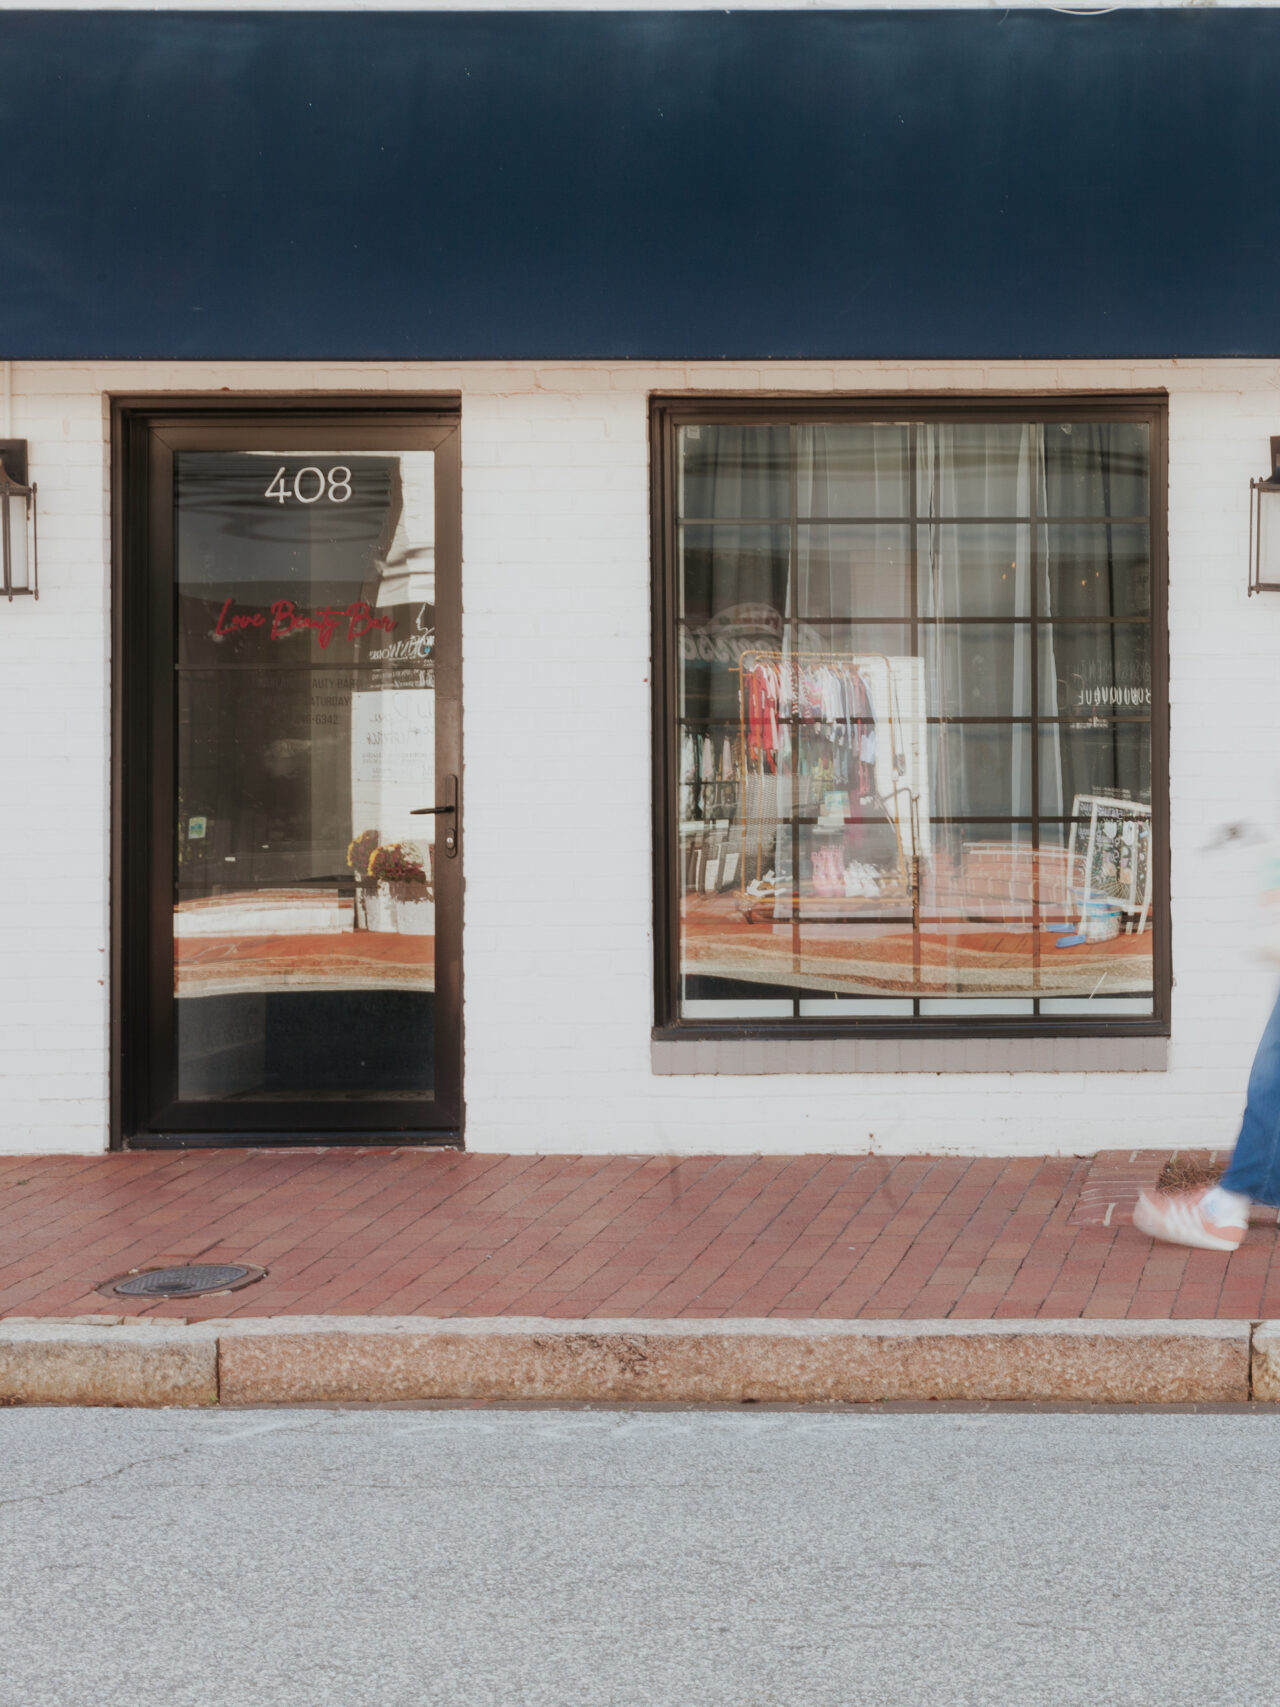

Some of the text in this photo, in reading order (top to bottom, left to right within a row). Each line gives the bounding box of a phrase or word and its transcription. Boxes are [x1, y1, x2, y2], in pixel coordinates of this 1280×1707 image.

[264, 466, 352, 504] 408
[215, 598, 266, 636] Love
[271, 600, 345, 650] Beauty
[346, 602, 396, 642] Bar
